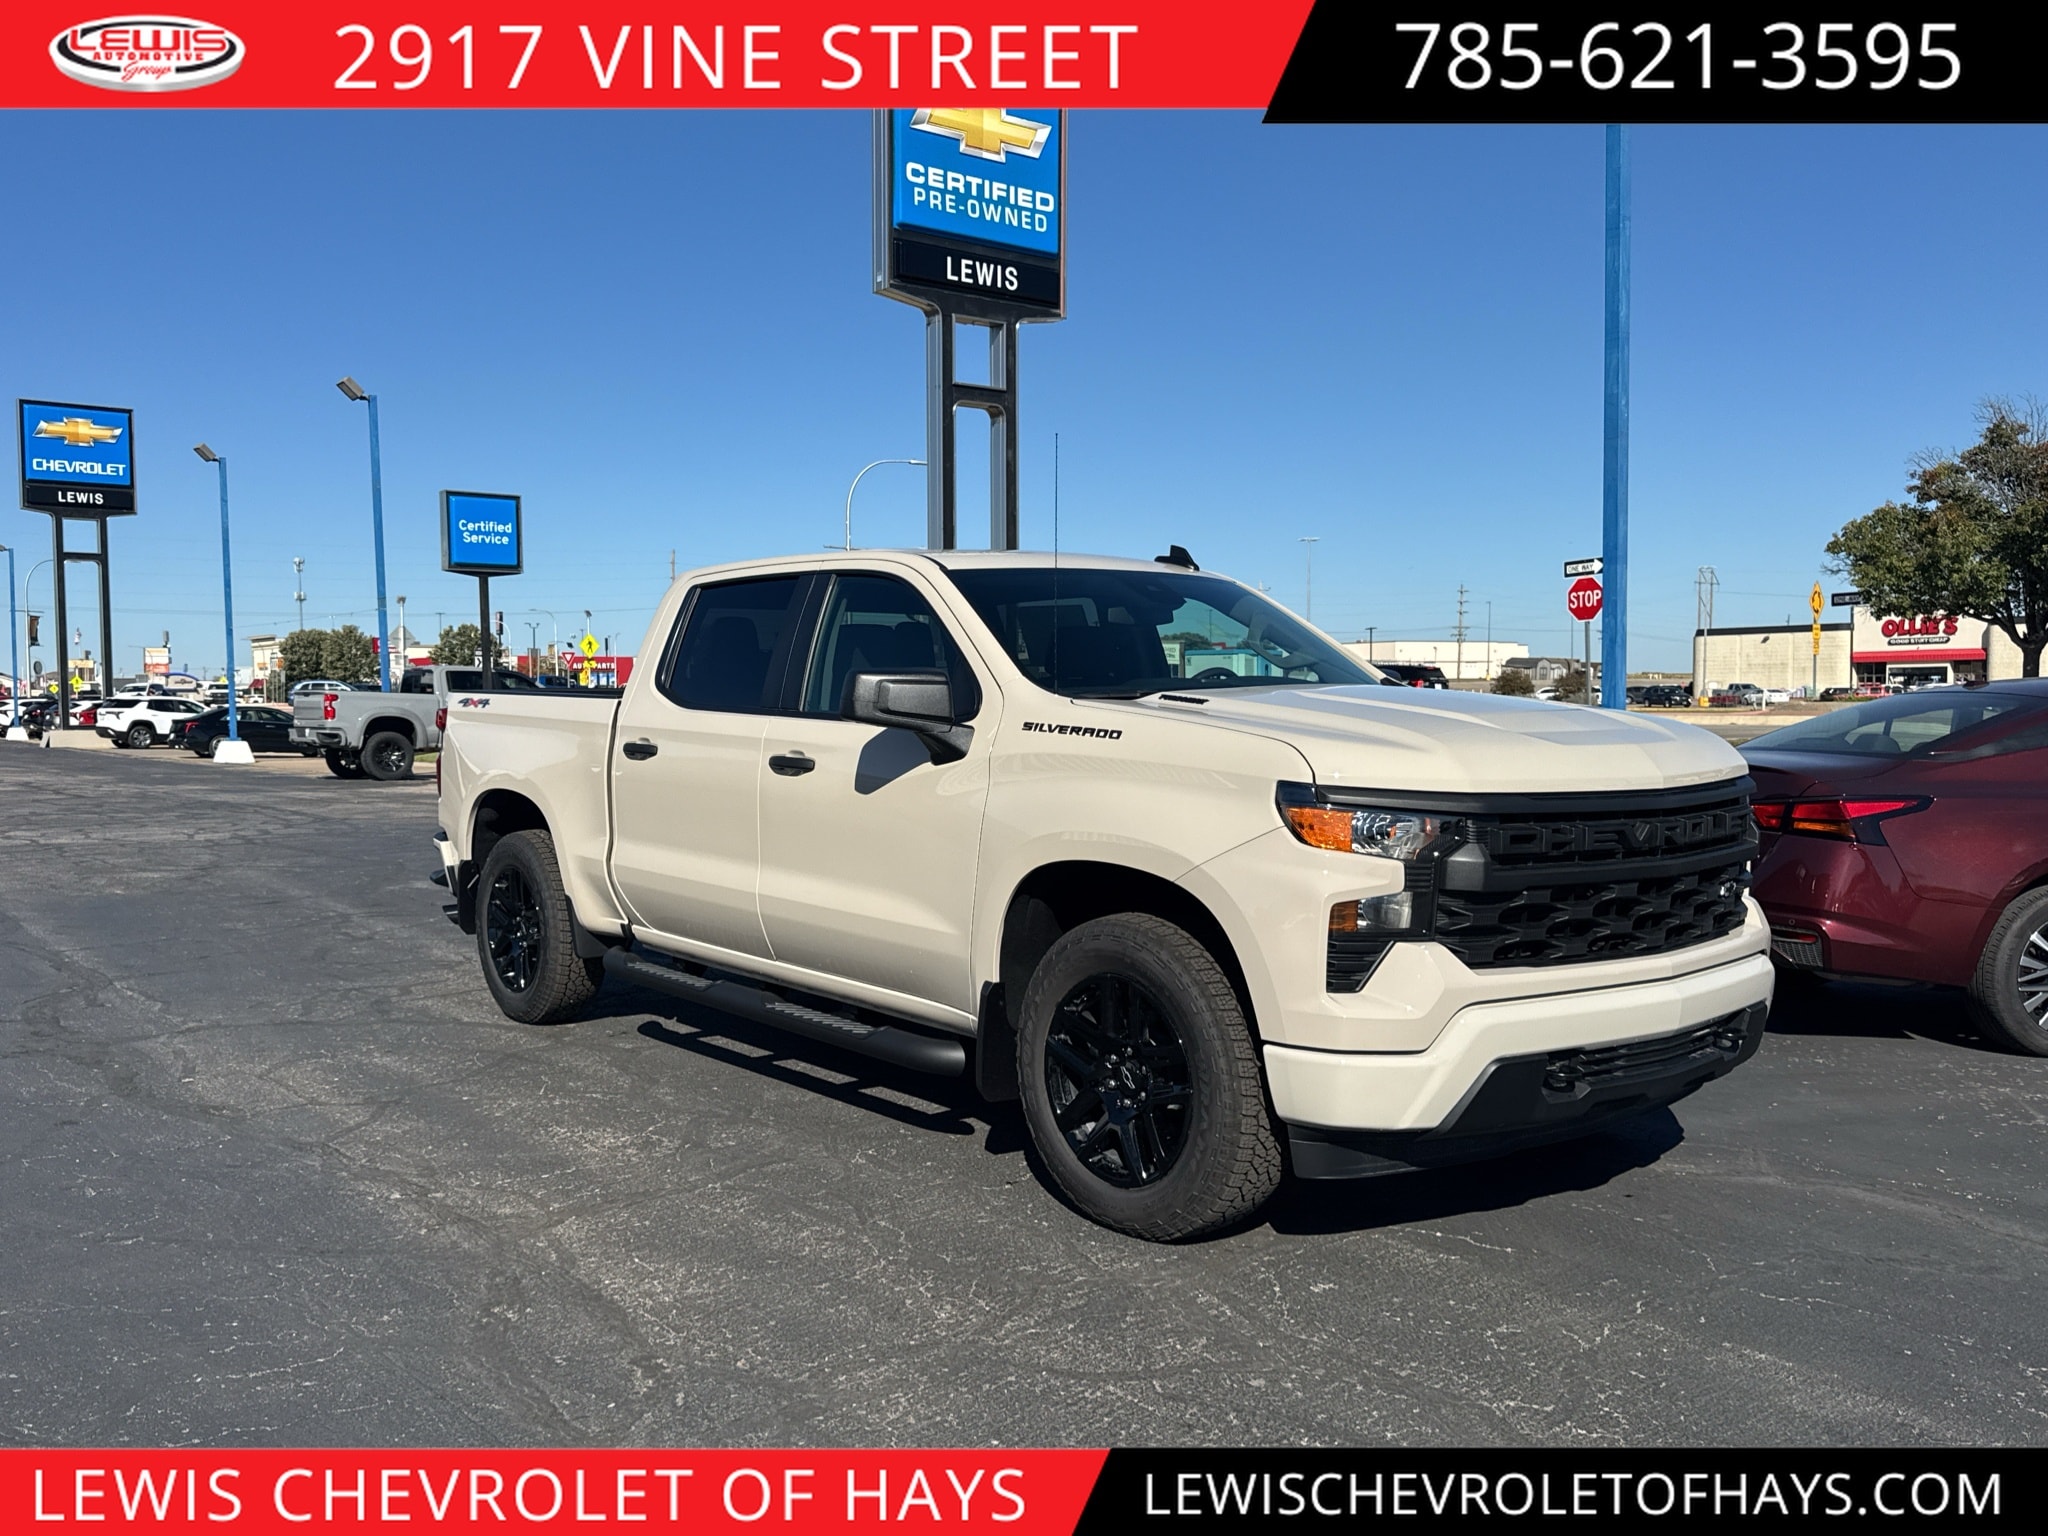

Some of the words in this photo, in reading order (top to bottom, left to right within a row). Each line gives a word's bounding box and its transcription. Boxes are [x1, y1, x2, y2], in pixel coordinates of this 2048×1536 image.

[906, 162, 1055, 213] CERTIFIED
[914, 187, 1047, 233] PRE-OWNED
[946, 256, 1018, 291] LEWIS
[32, 458, 126, 476] CHEVROLET
[58, 490, 104, 505] LEWIS
[458, 519, 512, 533] Certified
[463, 531, 510, 545] Service
[1581, 563, 1594, 571] WAY
[1570, 590, 1602, 609] STOP
[1022, 721, 1123, 740] SILVERADO
